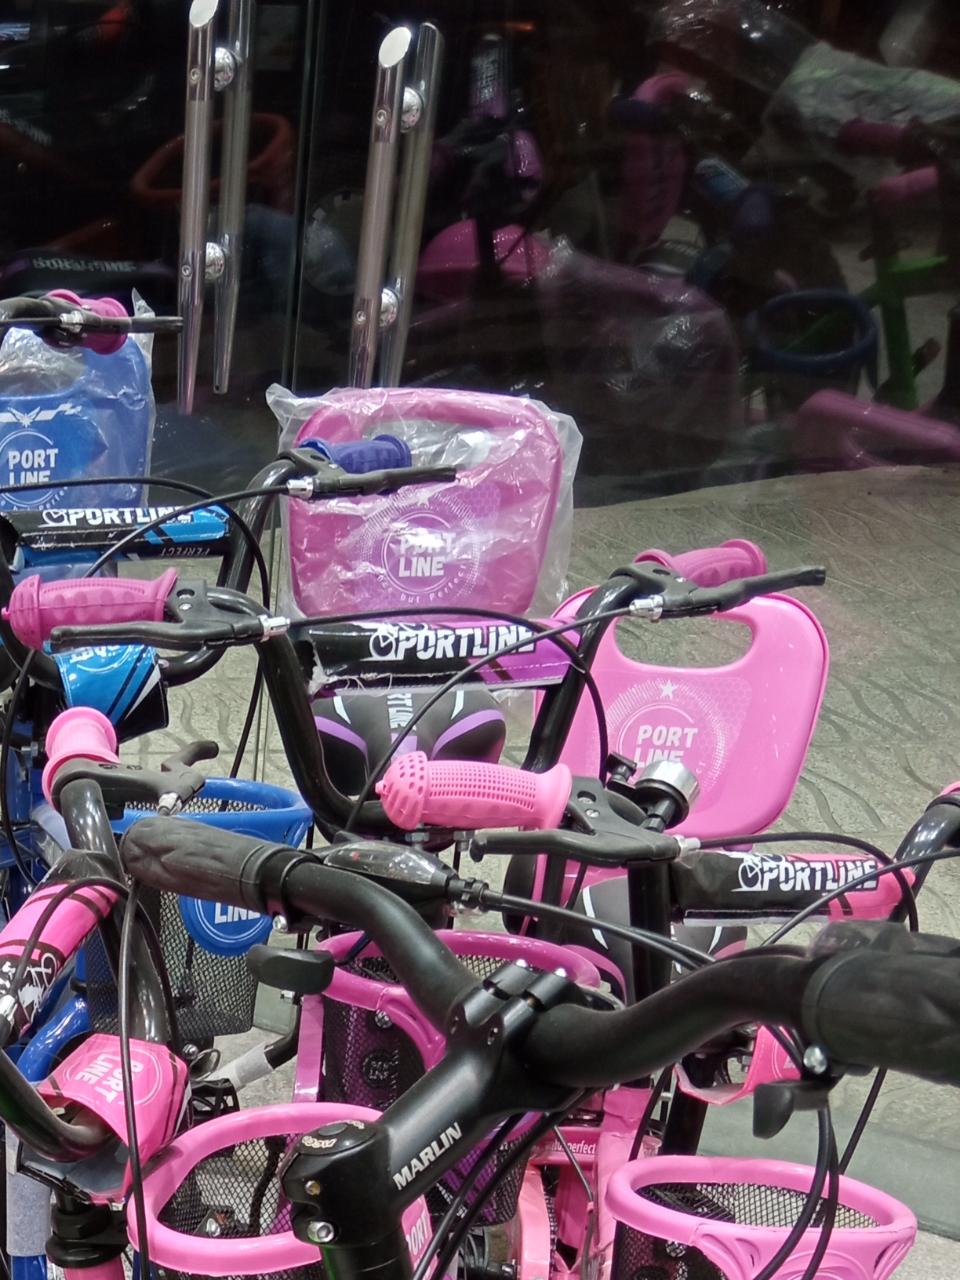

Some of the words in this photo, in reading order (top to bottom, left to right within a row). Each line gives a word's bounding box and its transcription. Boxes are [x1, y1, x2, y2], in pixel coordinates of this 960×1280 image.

[8, 449, 58, 470] PORT
[398, 556, 445, 577] LINE
[637, 725, 699, 748] PORT
[392, 1121, 463, 1190] MARLIN
